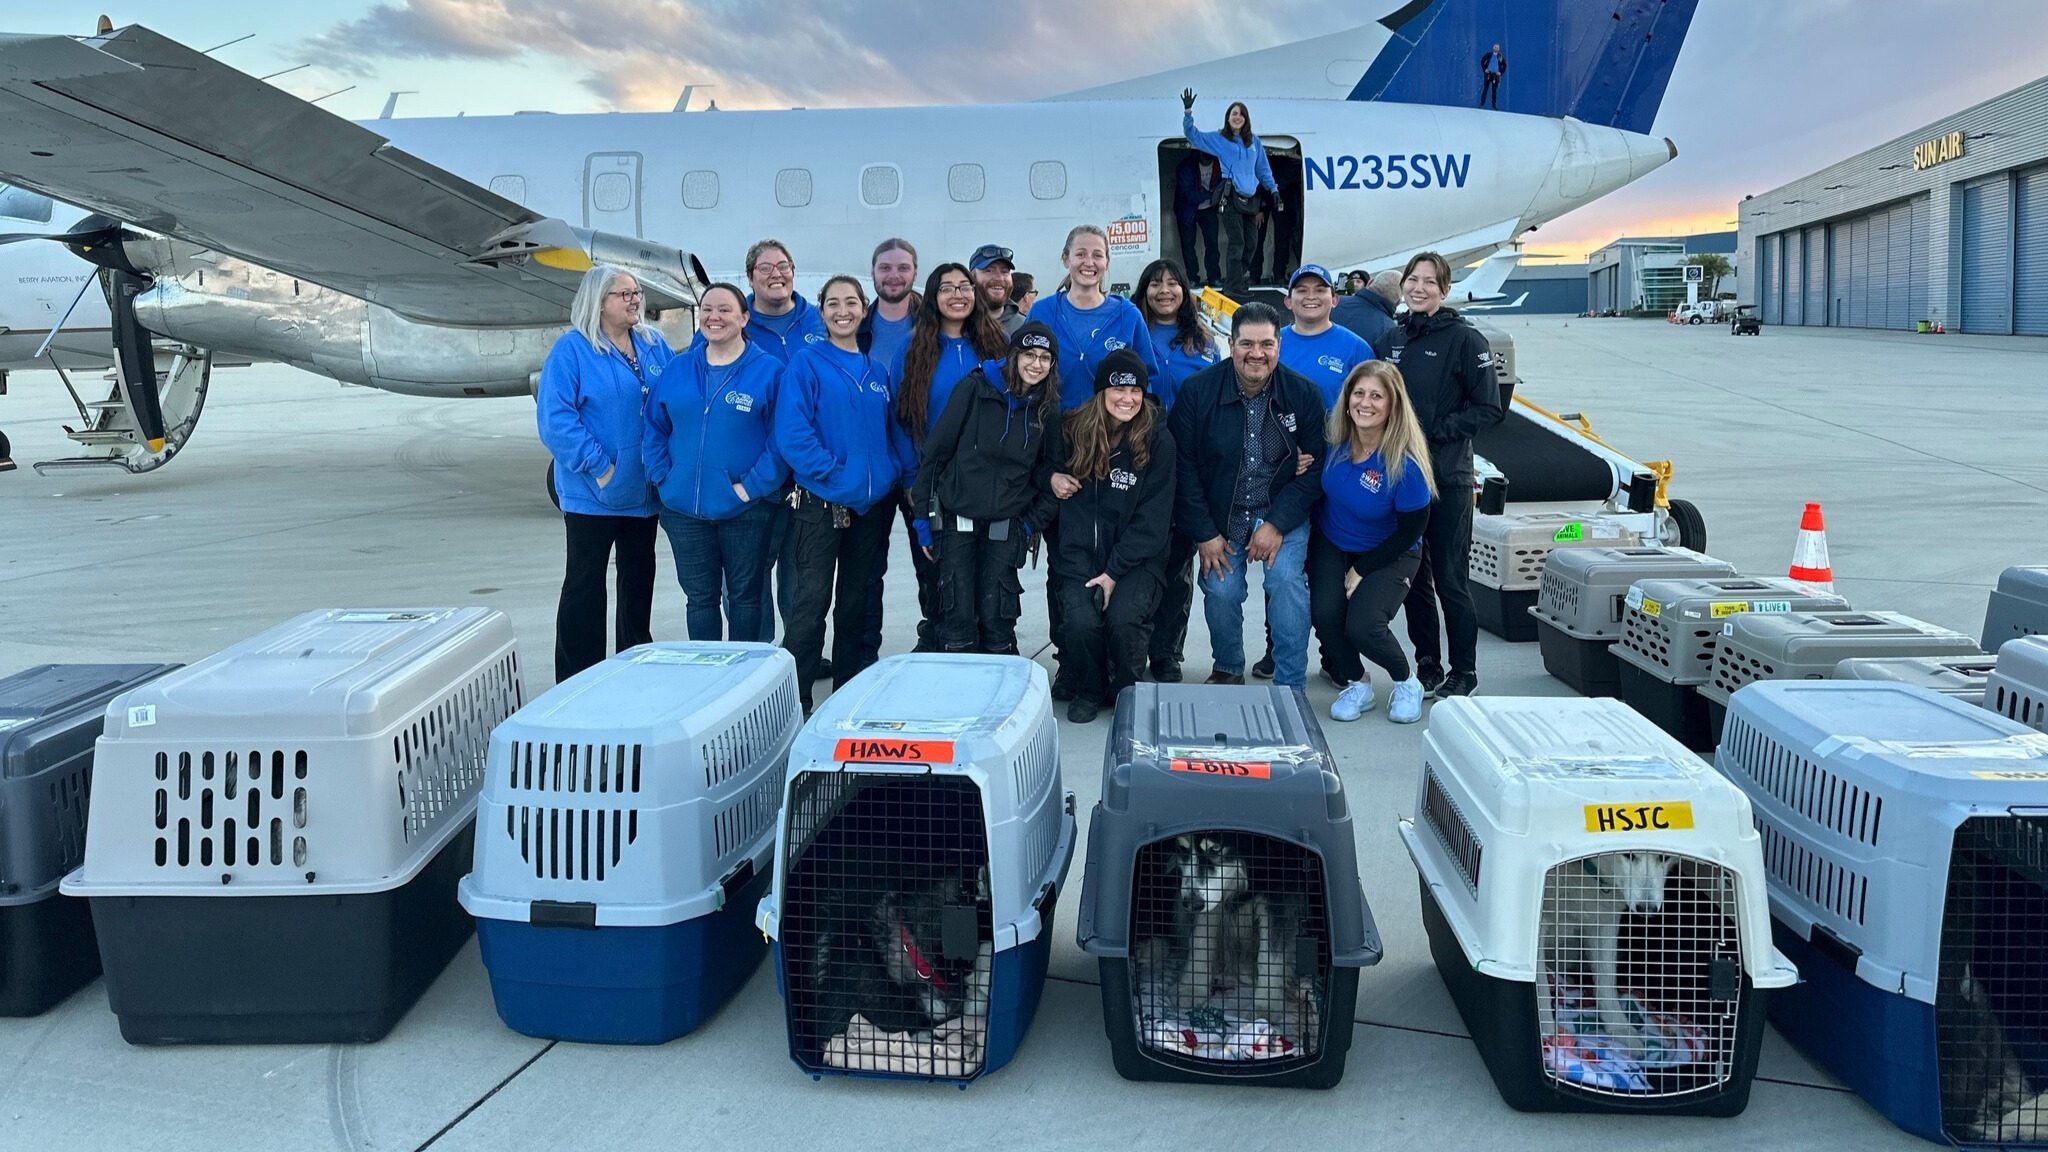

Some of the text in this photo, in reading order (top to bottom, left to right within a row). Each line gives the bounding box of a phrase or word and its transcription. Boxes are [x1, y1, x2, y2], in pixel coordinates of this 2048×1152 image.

[1913, 131, 1962, 170] SUN AIR
[1304, 153, 1472, 191] N235SW
[1110, 233, 1147, 244] PETS SAVED
[1765, 603, 1781, 612] LIVE
[849, 742, 922, 759] HAWS
[1597, 806, 1670, 832] HSJC
